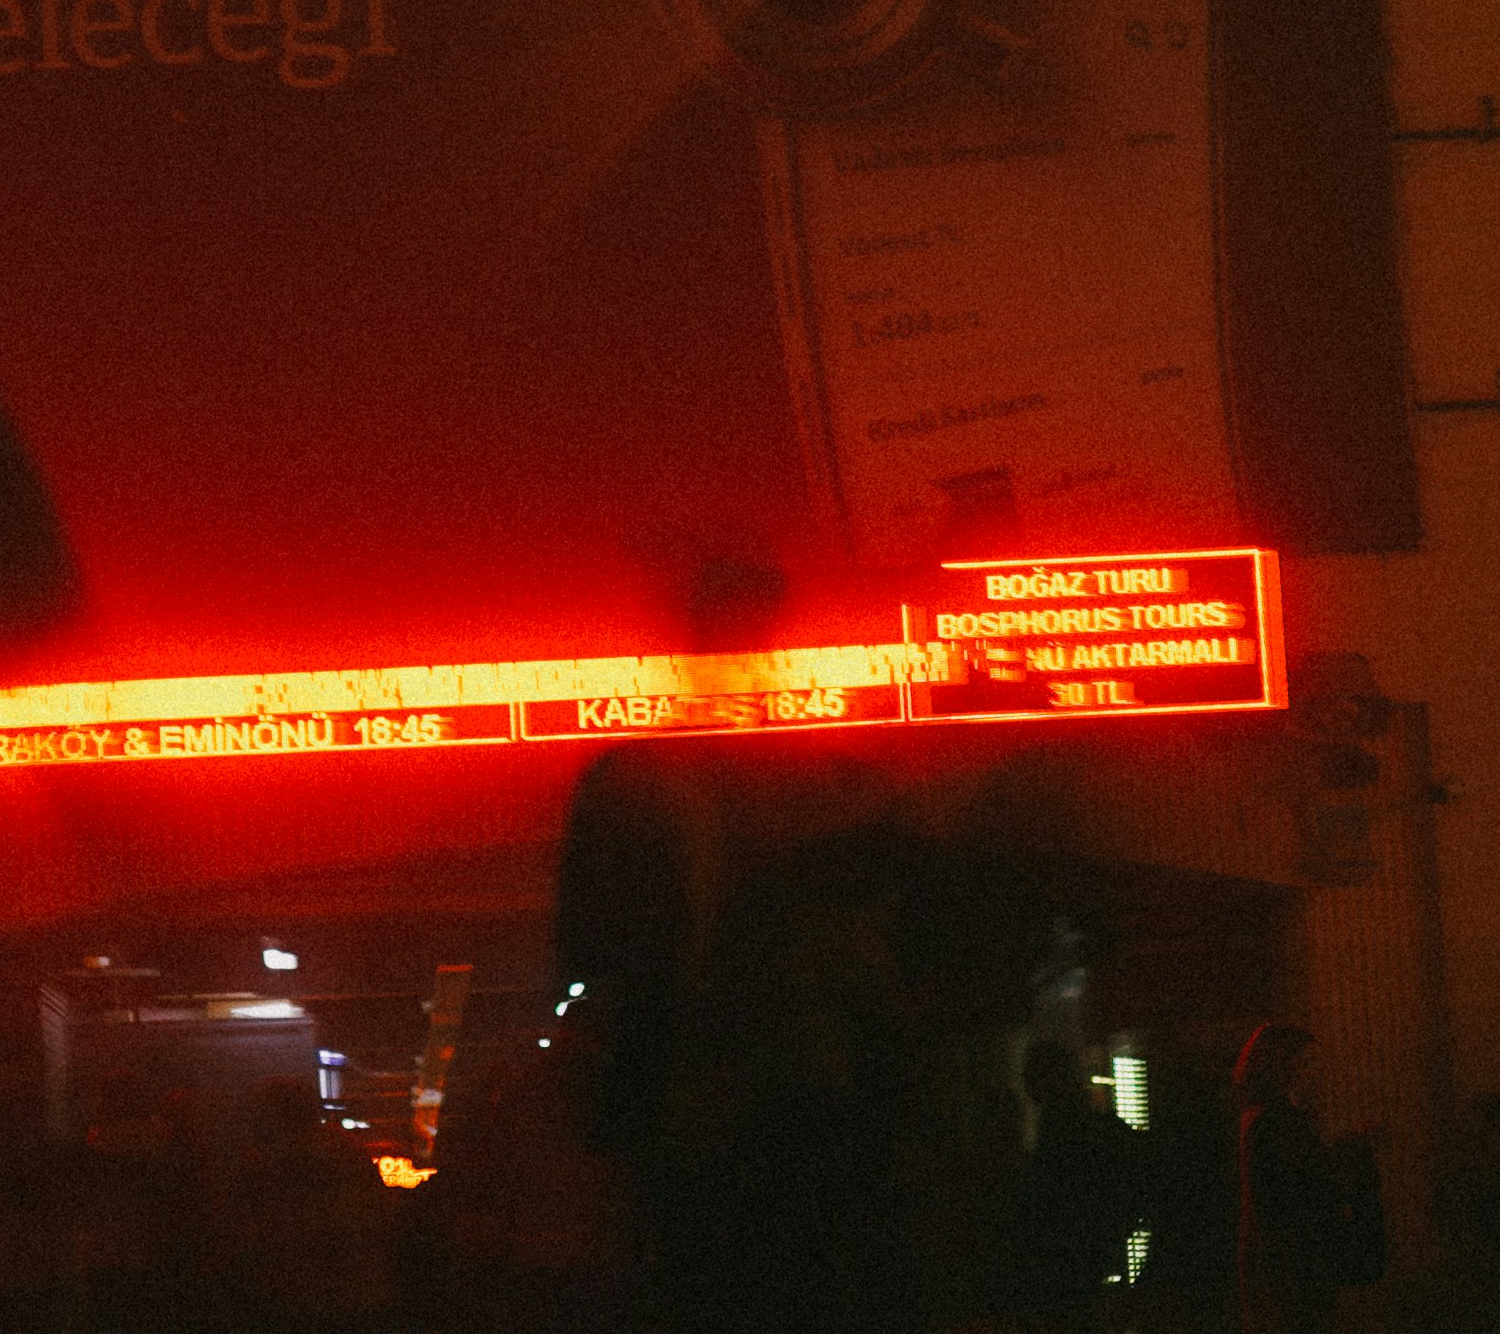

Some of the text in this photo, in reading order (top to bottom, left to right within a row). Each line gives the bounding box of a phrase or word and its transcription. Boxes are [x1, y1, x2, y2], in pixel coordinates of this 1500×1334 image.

[986, 564, 1176, 600] BOĞAZ TURU
[936, 600, 1229, 640] BOSPHORUS TOURS
[1071, 636, 1239, 671] AKTARMALI
[123, 727, 149, 757] &
[159, 711, 334, 756] EMİNÖNÜ
[352, 713, 442, 746] 18:45
